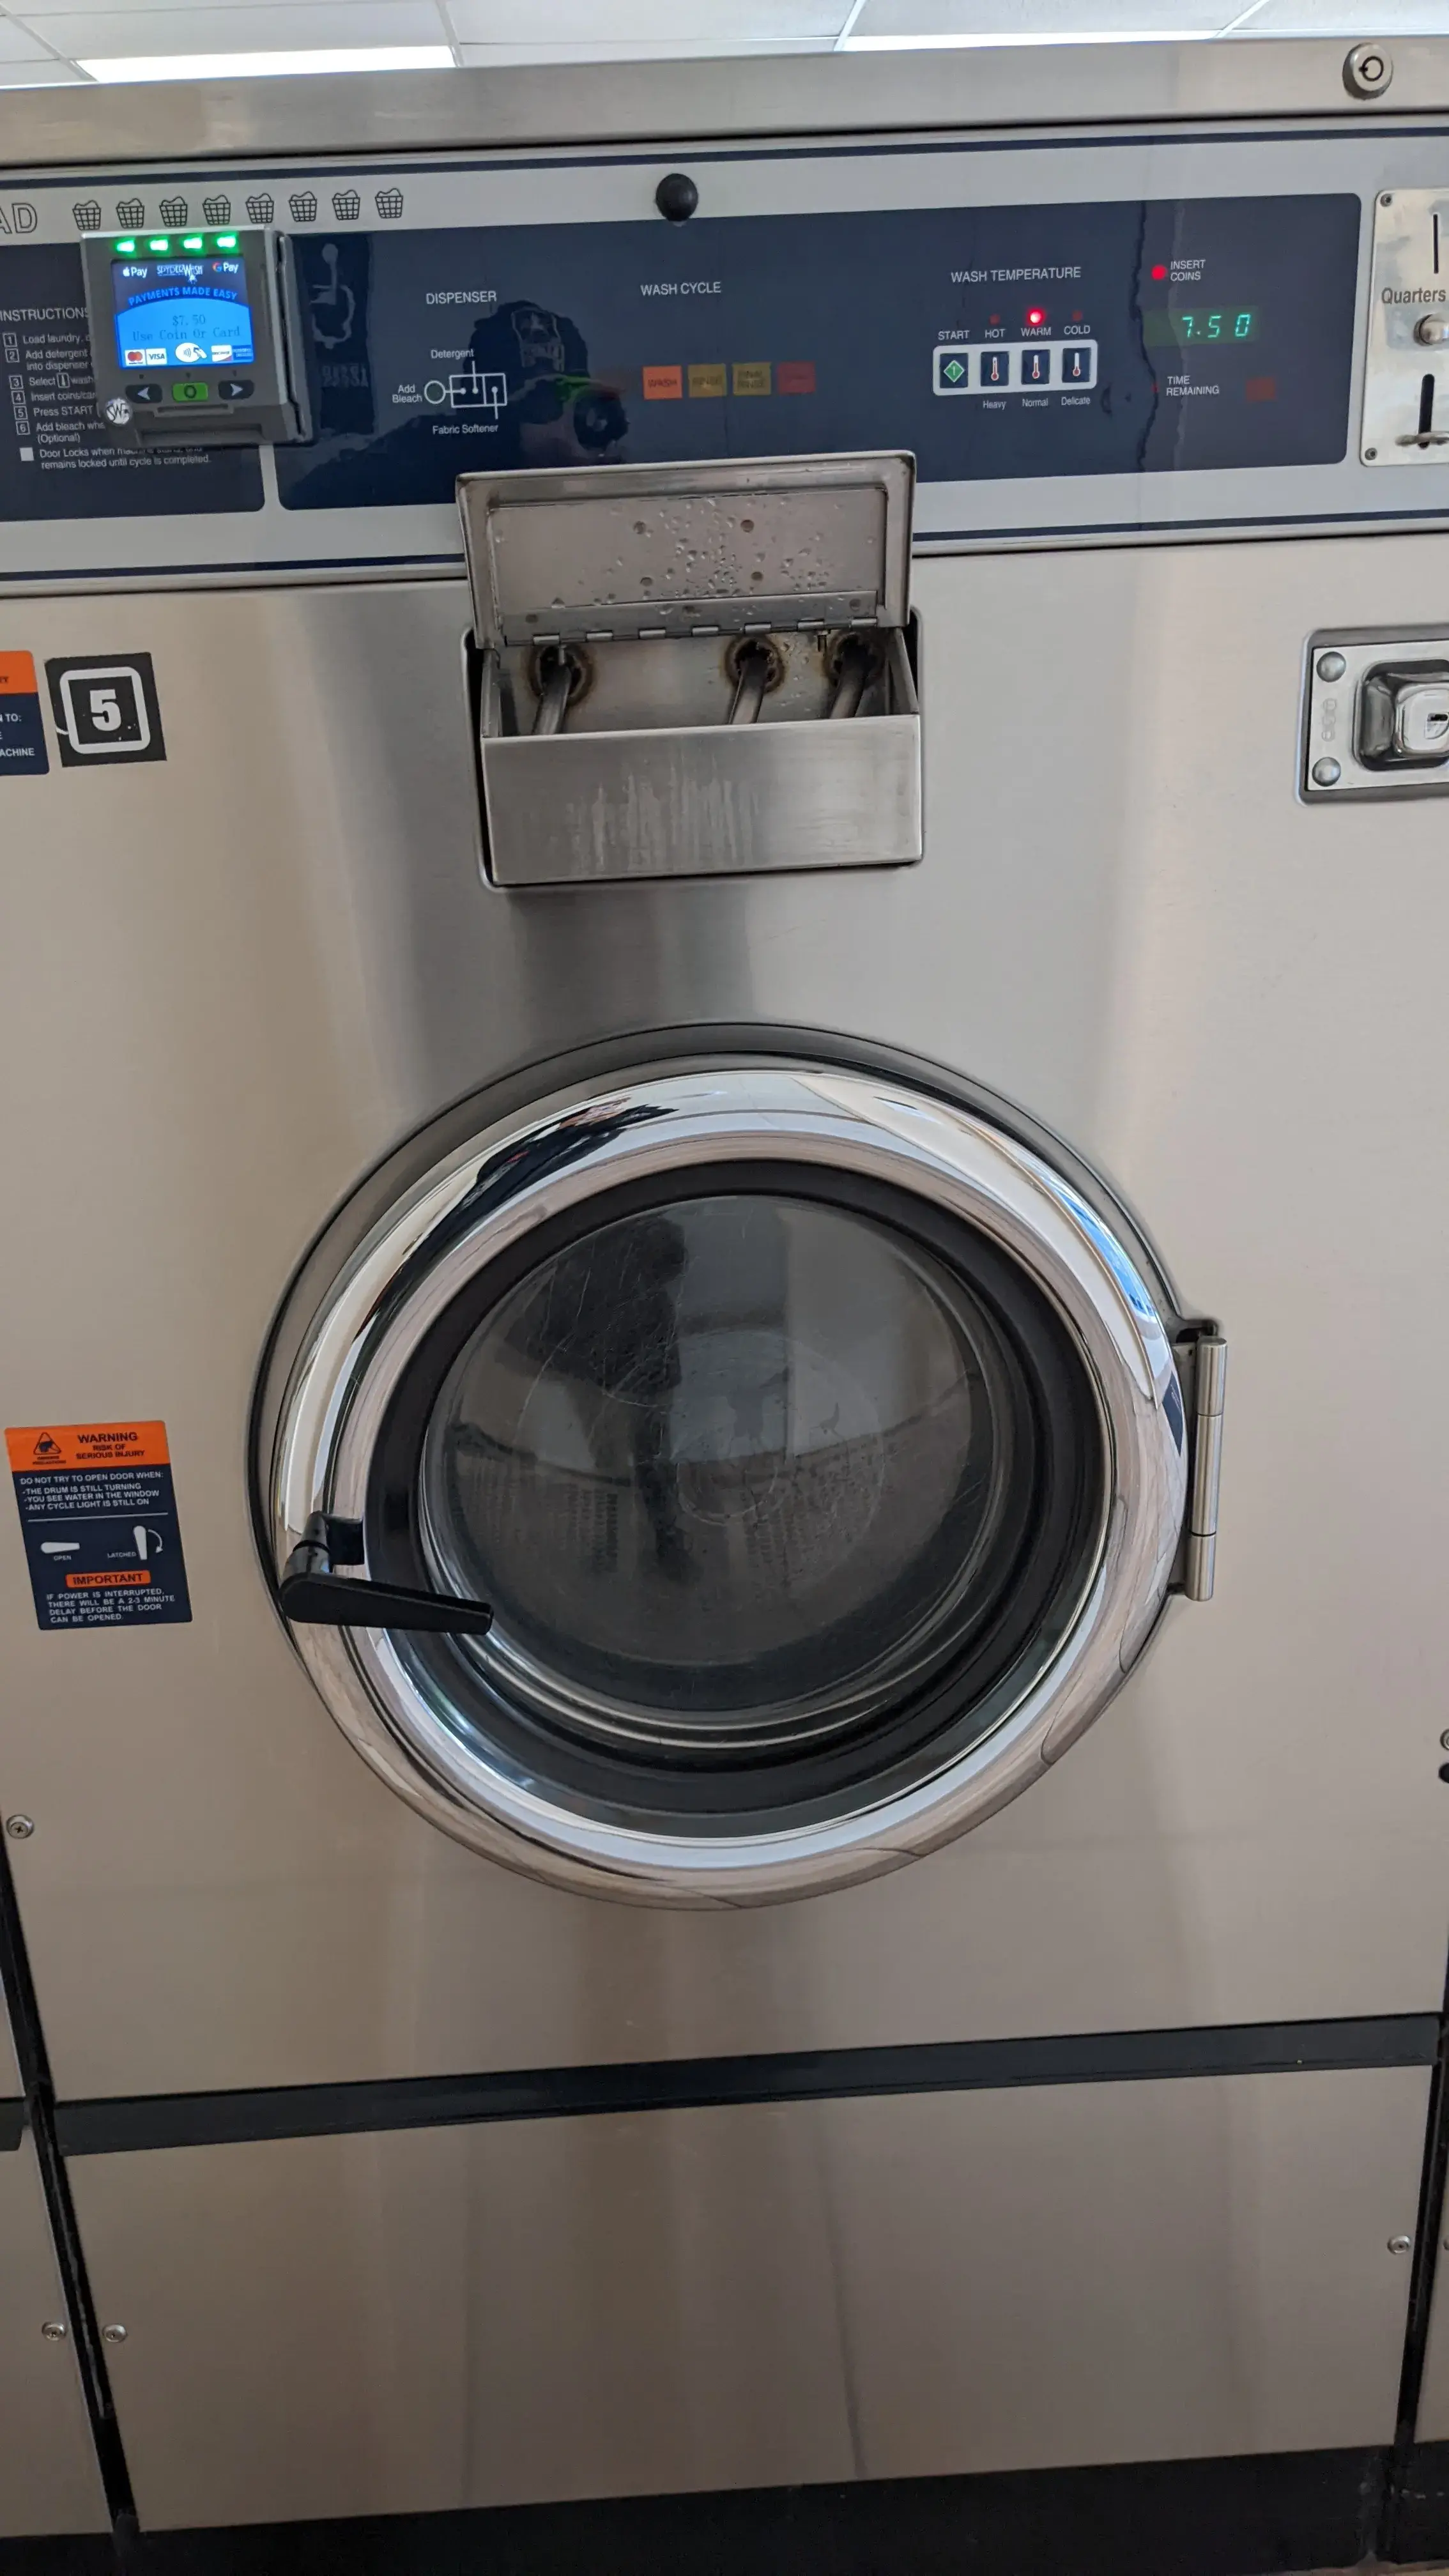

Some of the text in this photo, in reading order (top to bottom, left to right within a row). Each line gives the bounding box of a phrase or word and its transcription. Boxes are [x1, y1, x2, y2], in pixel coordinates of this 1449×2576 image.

[223, 261, 239, 273] Pay
[1170, 259, 1206, 270] INSERT
[131, 267, 148, 278] Pay
[951, 266, 1081, 283] WASH TEMPERATURE
[1170, 272, 1201, 282] COINS
[641, 282, 721, 296] WASH CYCLE
[128, 287, 238, 306] PAYMENTS MADE EASY
[426, 291, 497, 304] DISPENSER
[1381, 287, 1446, 304] Quarters
[132, 326, 240, 341] Use Coin Or Card
[985, 329, 1006, 338] HOT
[1021, 327, 1051, 337] WARM
[1064, 325, 1091, 335] COLD
[23, 334, 45, 344] Load
[938, 330, 970, 341] START
[26, 351, 43, 359] Add
[46, 349, 88, 360] detergent
[431, 349, 473, 360] Detergent
[27, 362, 88, 372] into dispenser
[29, 377, 55, 386] Select
[648, 378, 677, 388] WASH
[1167, 376, 1190, 385] TIME
[398, 385, 415, 393] Add
[1166, 386, 1220, 396] REMAINING
[31, 392, 54, 401] Insert
[392, 394, 422, 403] Bleach
[1061, 397, 1091, 406] Delicate
[983, 401, 1006, 410] Heavy
[1022, 398, 1048, 407] Normal
[33, 408, 58, 417] Press
[61, 405, 93, 415] START
[36, 423, 54, 431] Add
[56, 422, 85, 431] bleach
[433, 424, 498, 434] Fabric Softener
[37, 434, 80, 444] (Optional)
[40, 449, 61, 458] Door
[64, 448, 89, 457] Locks
[92, 447, 115, 456] when
[41, 460, 76, 469] remains
[78, 459, 107, 468] locked
[130, 457, 151, 468] cycle
[89, 689, 121, 732] 5
[5, 713, 22, 722] TO:
[77, 1432, 137, 1443] WARNING
[75, 1452, 113, 1460] SERIOUS
[73, 1574, 143, 1584] IMPORTANT
